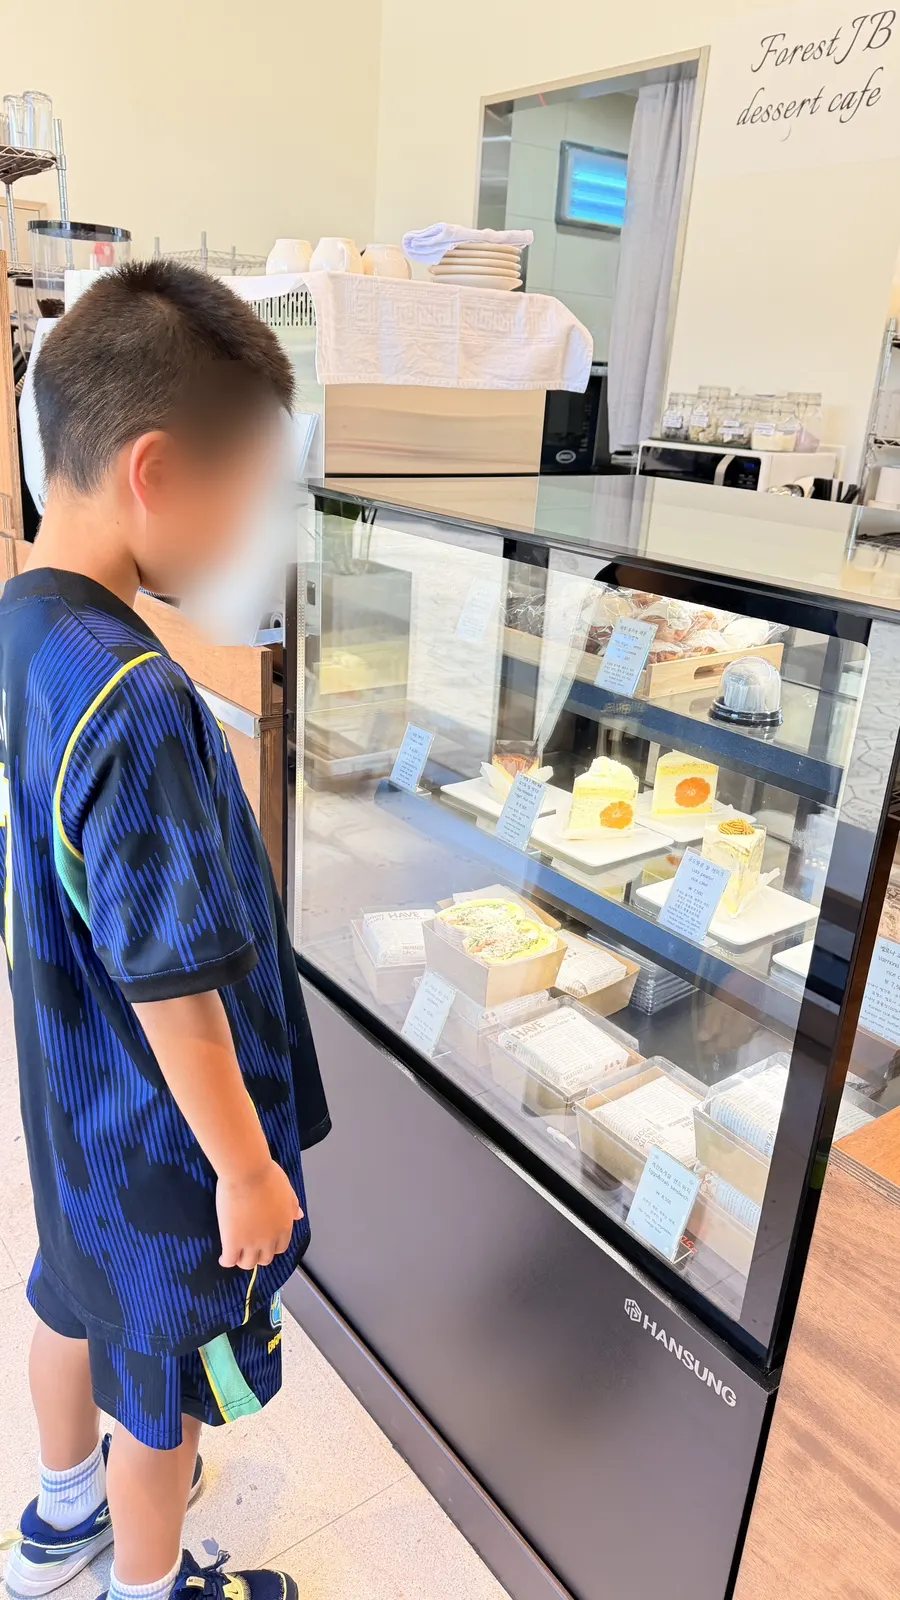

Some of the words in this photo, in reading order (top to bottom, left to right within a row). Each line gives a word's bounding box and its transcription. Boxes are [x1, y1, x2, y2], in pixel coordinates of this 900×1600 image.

[751, 26, 843, 73] Forest
[834, 10, 897, 65] JB
[736, 86, 826, 126] dessert
[827, 66, 884, 124] cafe
[388, 911, 421, 919] HAVE
[510, 1021, 546, 1040] HAVE
[673, 1178, 692, 1195] 샌드위치
[643, 1314, 737, 1407] HANSUNG
